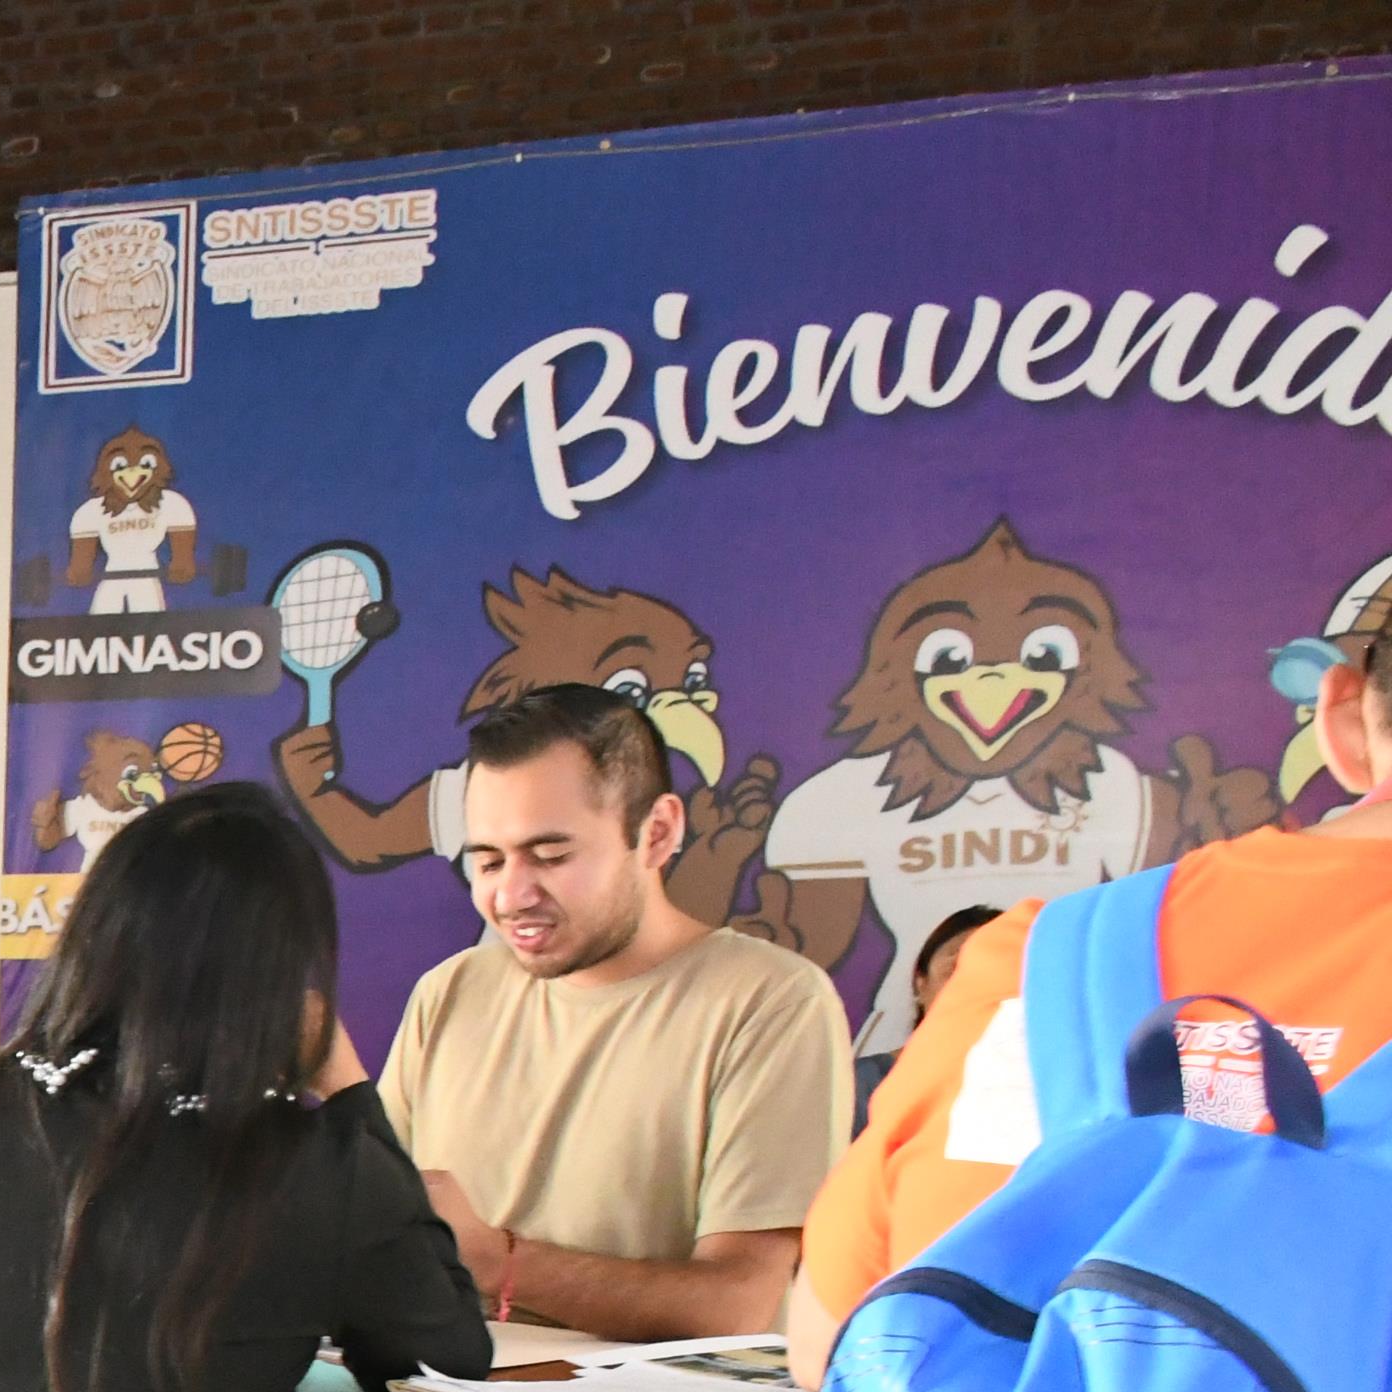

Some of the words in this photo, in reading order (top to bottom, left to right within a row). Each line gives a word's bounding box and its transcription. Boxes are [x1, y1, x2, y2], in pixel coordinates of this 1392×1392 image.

[209, 194, 432, 244] SNTISSSTE
[466, 223, 1392, 520] Bienvenid
[17, 629, 264, 678] GIMNASIO
